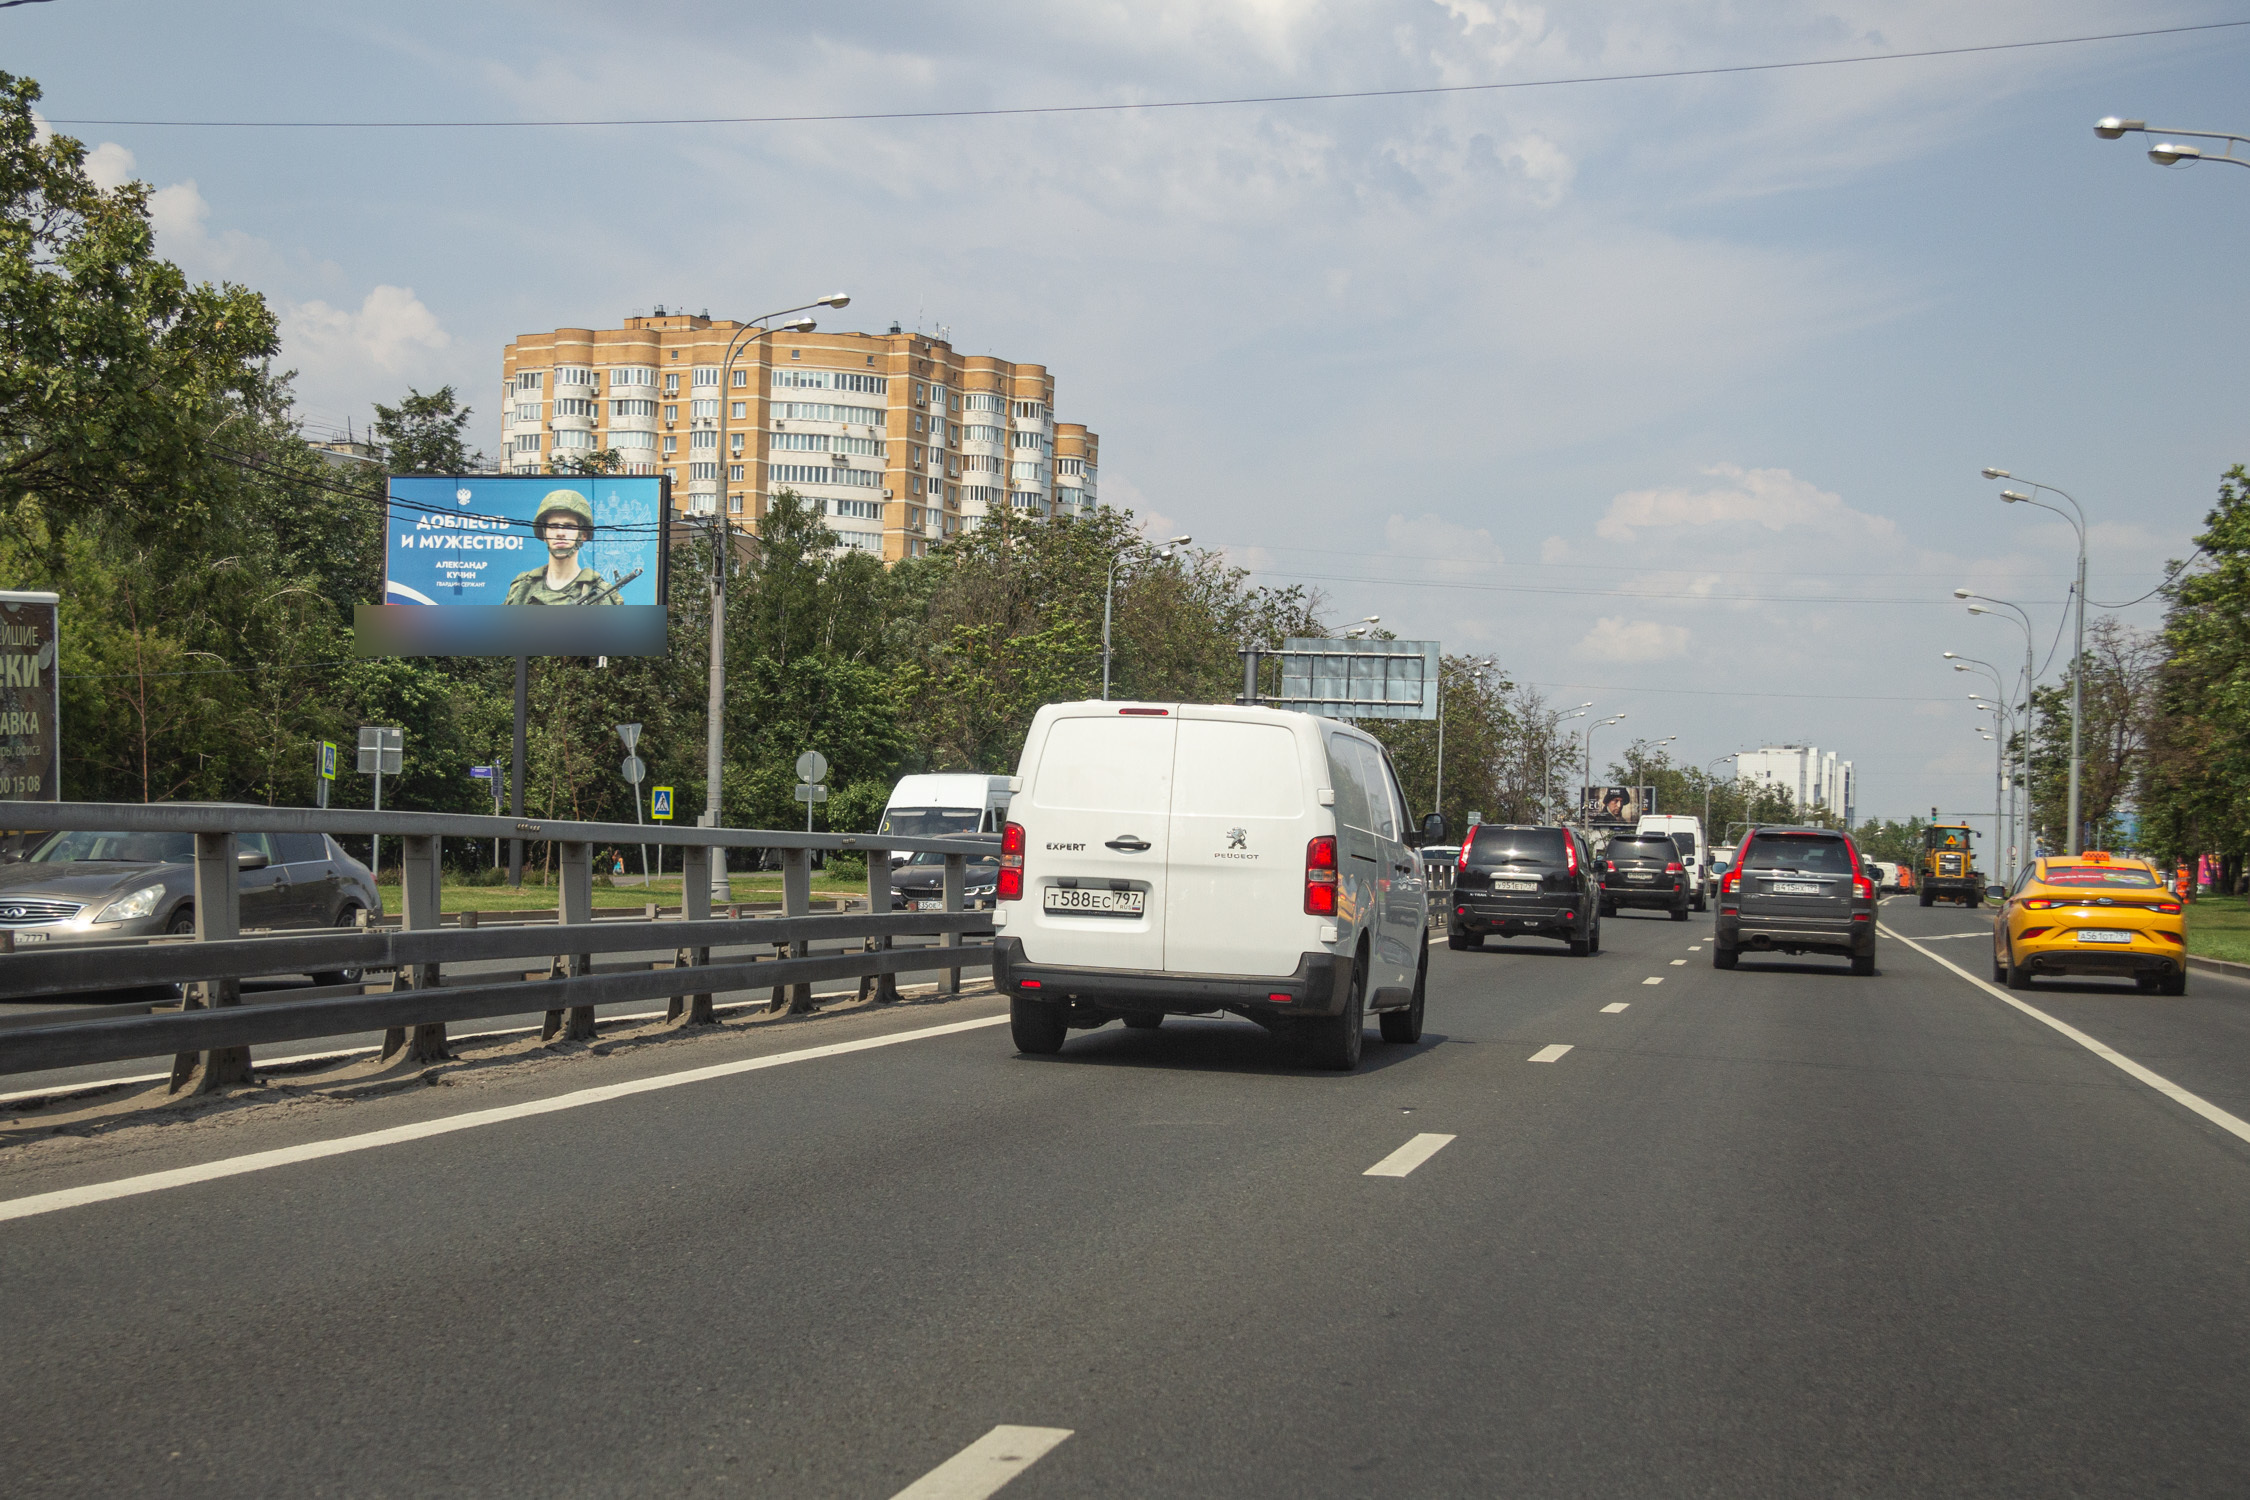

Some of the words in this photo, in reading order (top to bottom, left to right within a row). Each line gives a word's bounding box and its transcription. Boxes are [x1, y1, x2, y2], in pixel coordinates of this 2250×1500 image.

[416, 514, 511, 531] ДОБЛЕСТЬ
[401, 534, 414, 548] И
[419, 535, 524, 550] МУЖЕСТВО!
[435, 561, 488, 570] АЛЕКСАНДР
[446, 571, 476, 579] КУЧИН
[0, 620, 39, 646] ЙШИЕ
[1046, 842, 1086, 851] EXPERT
[1214, 852, 1259, 860] PEUGEOT
[1050, 890, 1111, 908] Т588ЕС
[1114, 892, 1139, 906] 797
